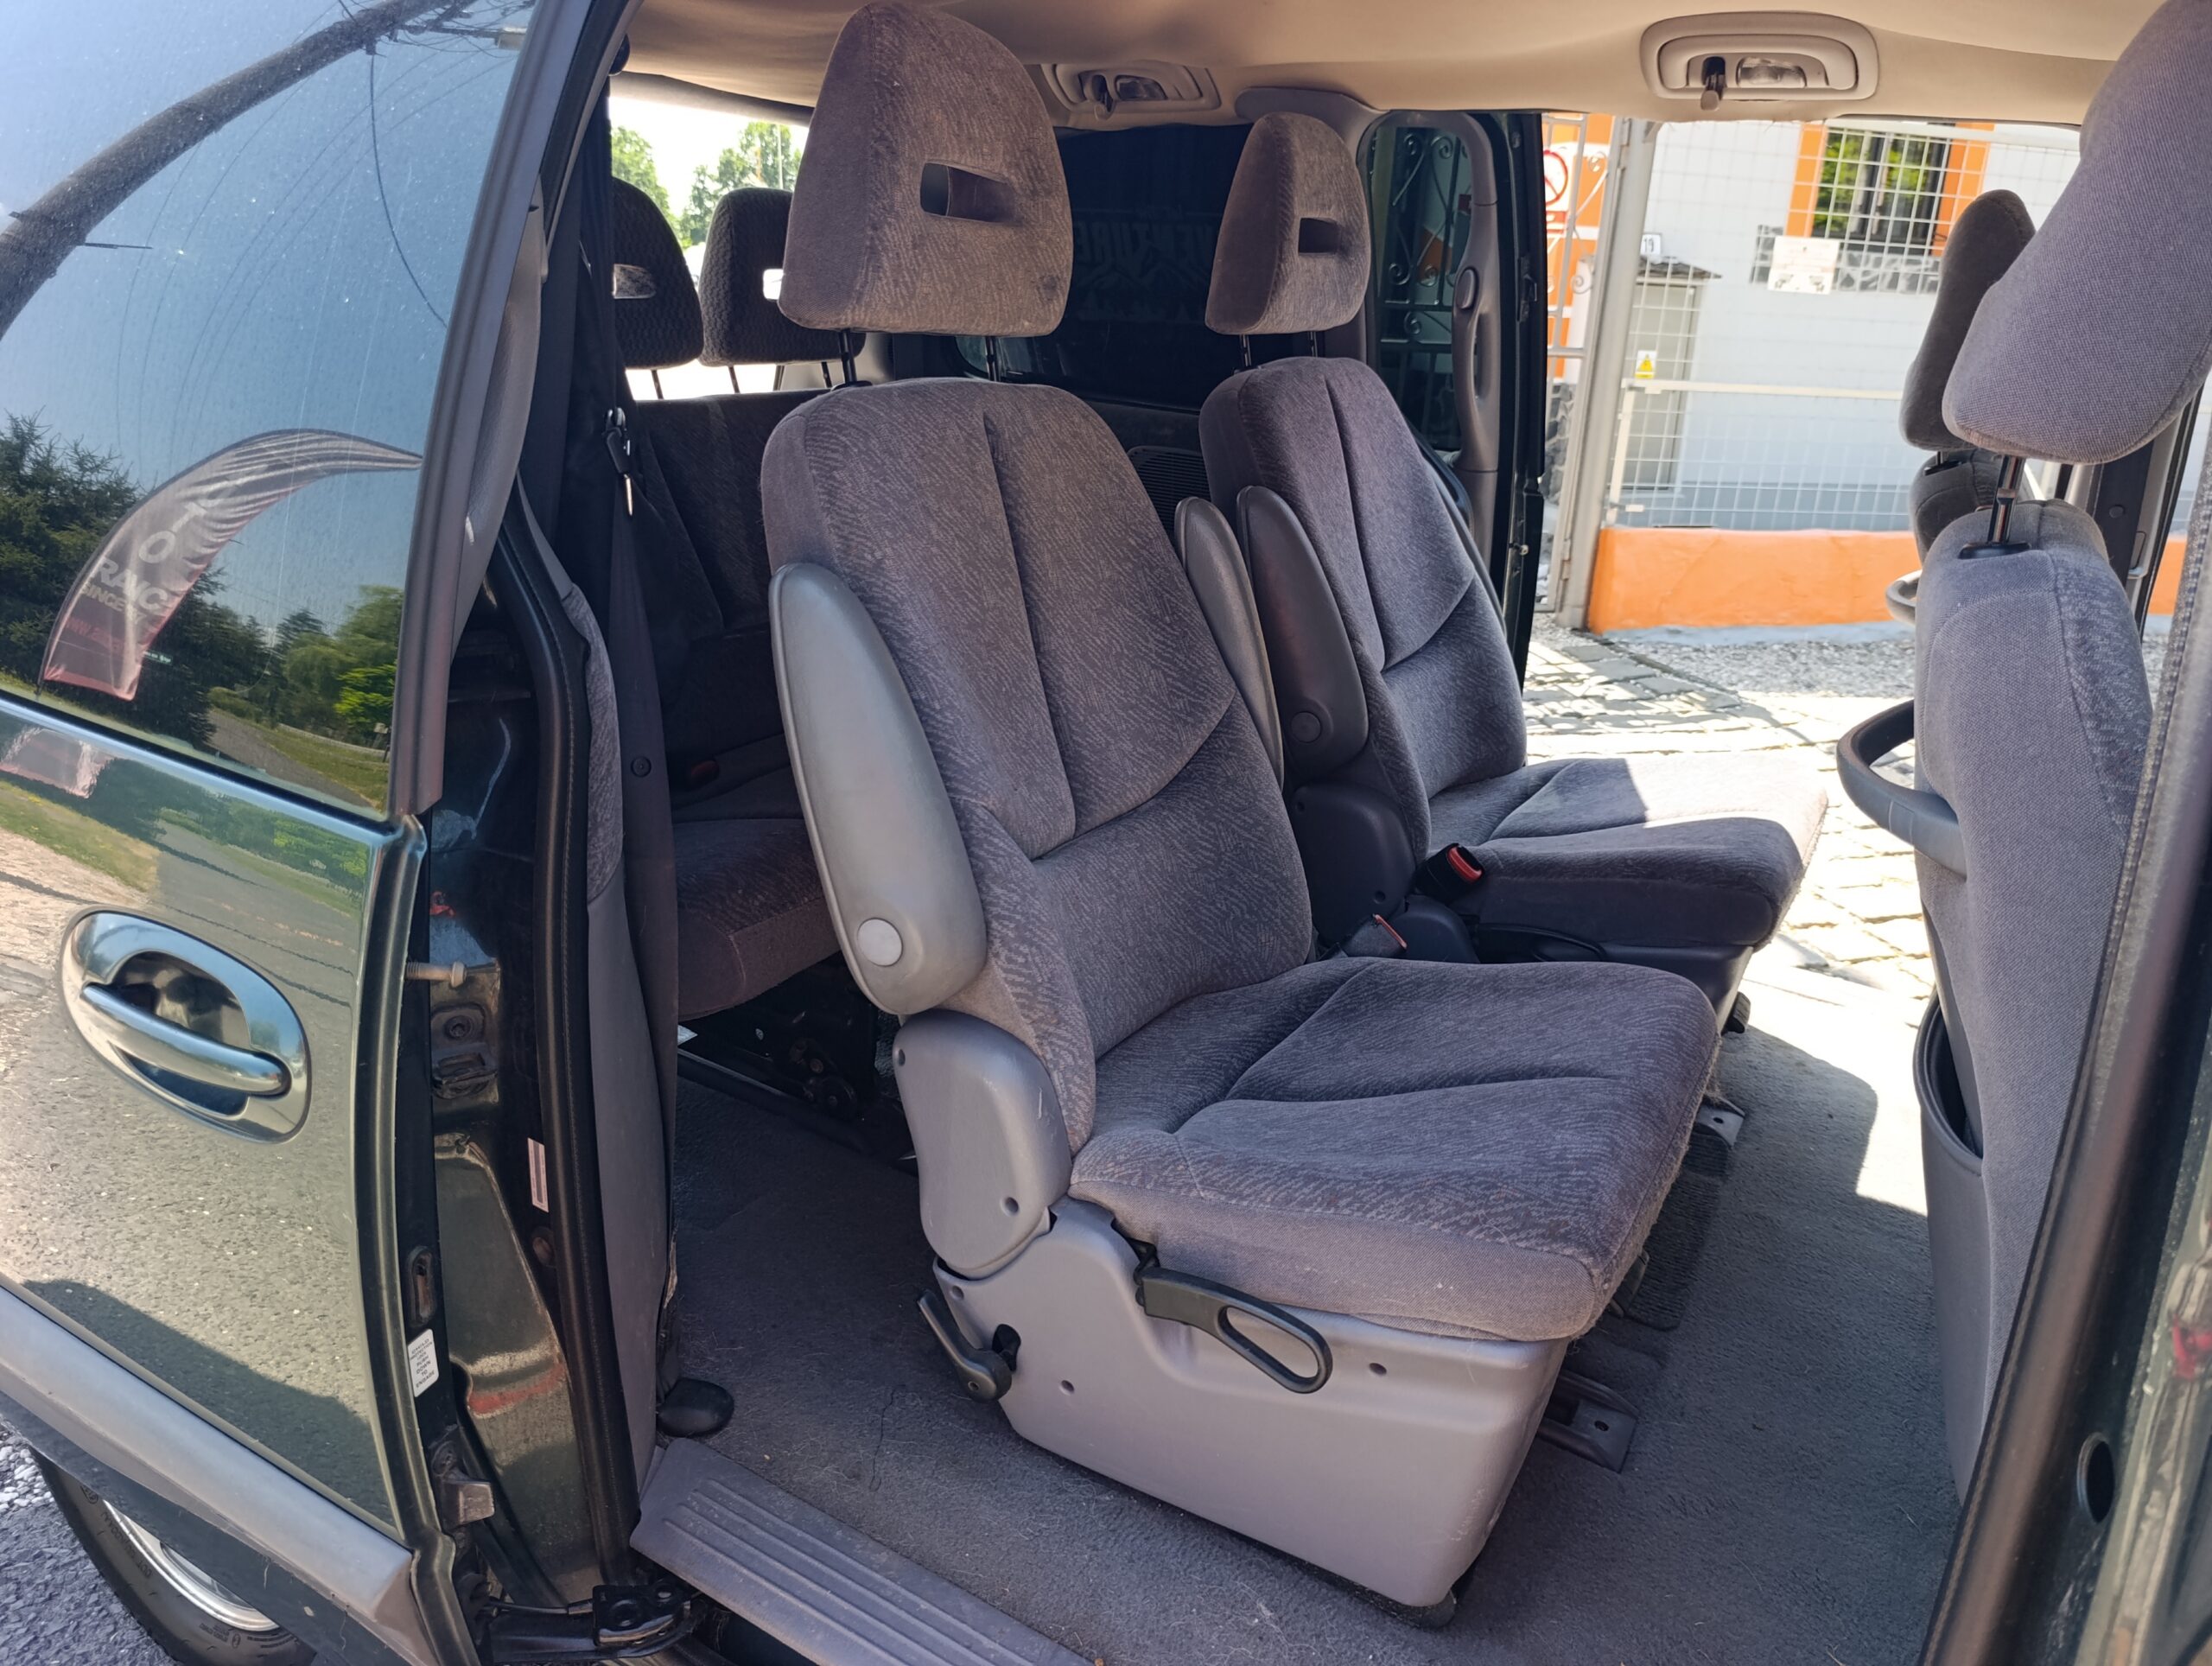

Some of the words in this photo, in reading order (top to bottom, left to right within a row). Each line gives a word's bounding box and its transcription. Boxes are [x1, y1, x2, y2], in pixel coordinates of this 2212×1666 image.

[411, 1339, 429, 1354] CHILD
[416, 1360, 431, 1375] DOWN
[416, 1370, 435, 1388] ENGAGE
